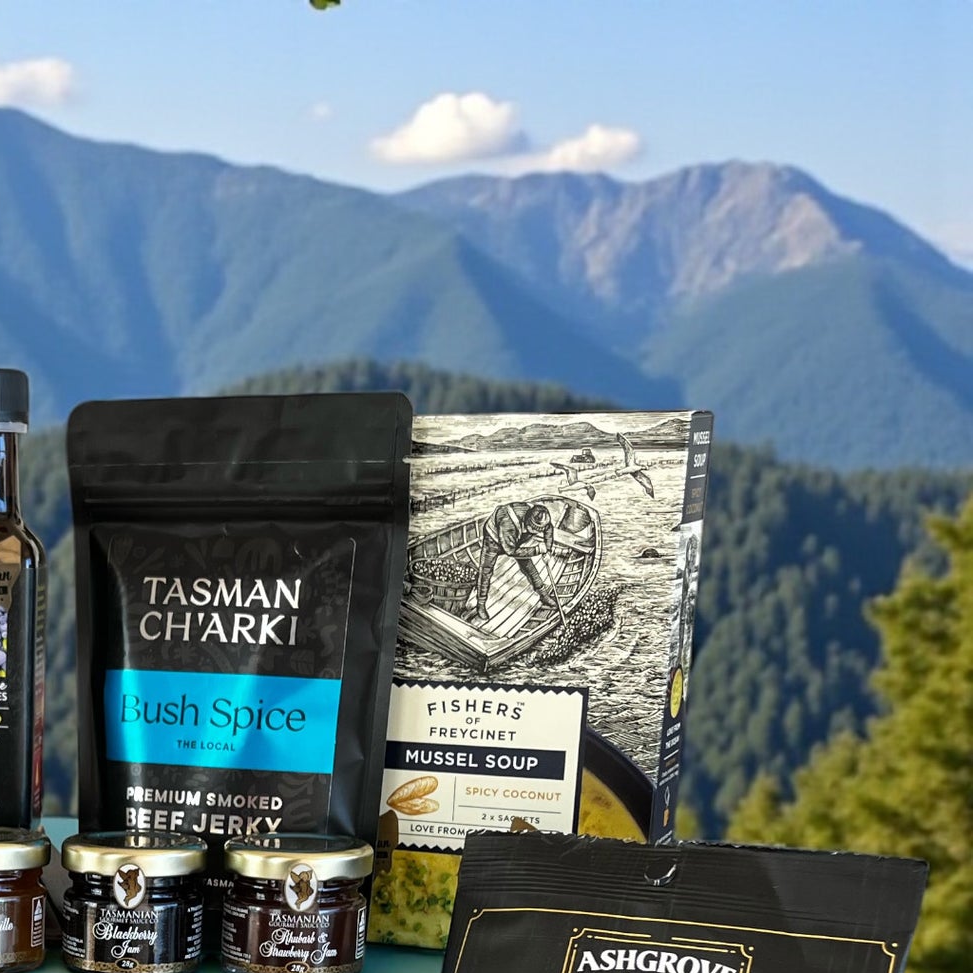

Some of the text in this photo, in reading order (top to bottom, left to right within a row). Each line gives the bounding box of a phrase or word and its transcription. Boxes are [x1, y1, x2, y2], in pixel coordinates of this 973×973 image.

[143, 576, 301, 609] TASMAN
[139, 611, 299, 645] CH'ARKI
[121, 693, 306, 736] Bush Spice
[427, 699, 523, 720] FISHERS
[429, 726, 517, 742] FREYCINET
[177, 740, 235, 752] THE LOCAL
[405, 750, 539, 770] MUSSEL SOUP
[126, 786, 283, 810] PREMIUM SMOKED
[465, 786, 561, 801] SPICY COCONUT
[125, 807, 283, 835] BEEF JERKY
[411, 824, 465, 836] LOVE FROM
[100, 908, 159, 919] TASMANIAN
[271, 914, 330, 924] TASMANIAN
[93, 921, 158, 945] Blackberry
[271, 928, 315, 945] Rhubarb
[111, 940, 140, 958] Jam
[259, 940, 309, 962] Strawberry
[310, 942, 337, 964] Jam
[121, 960, 135, 968] 28g
[291, 964, 305, 973] 28g
